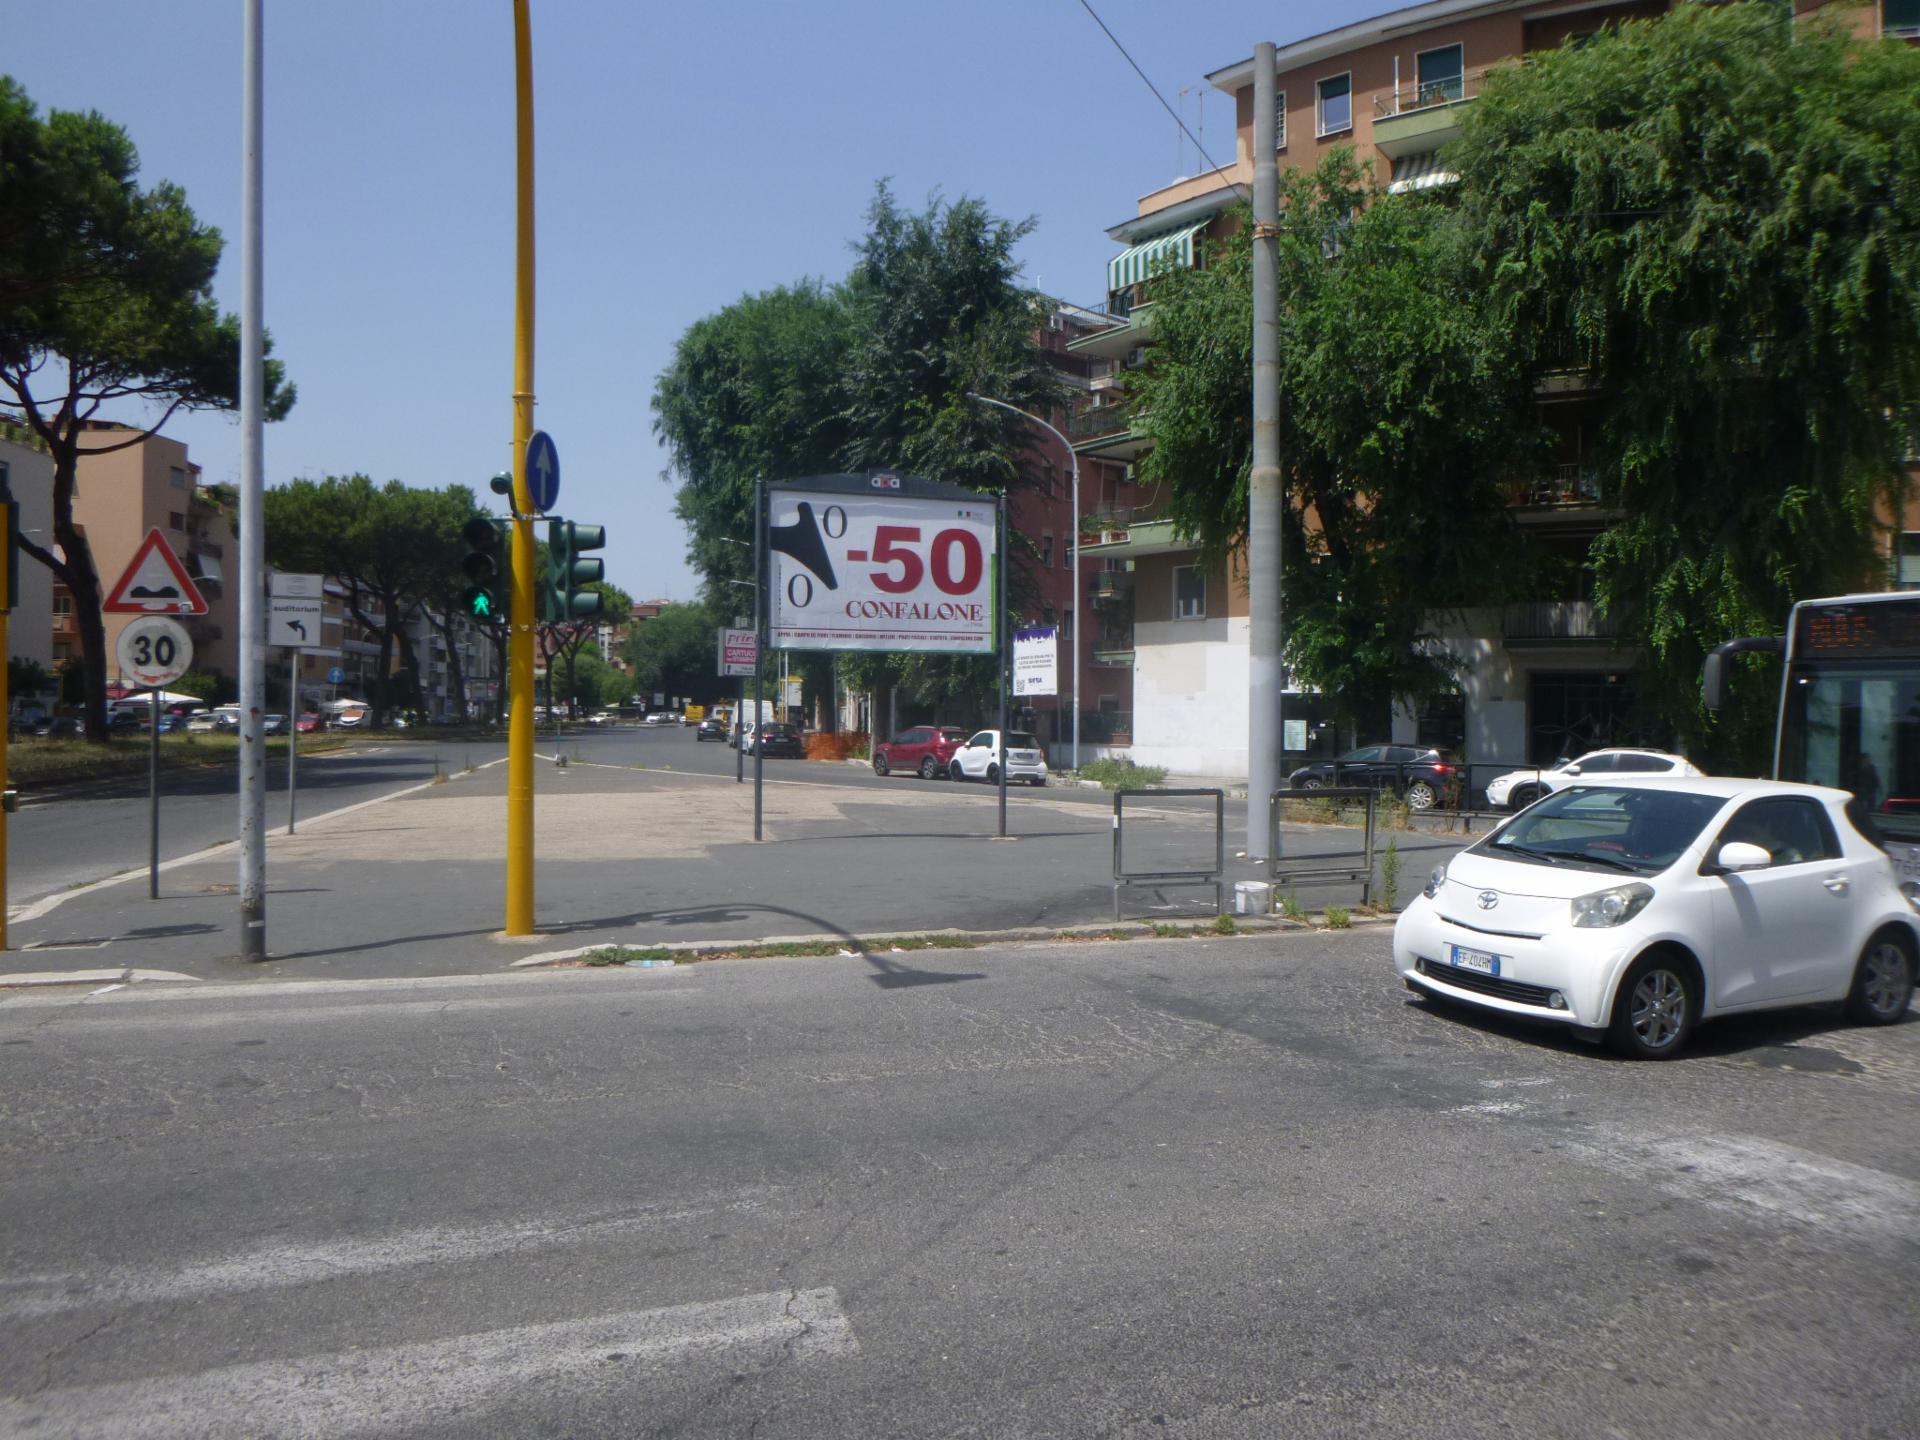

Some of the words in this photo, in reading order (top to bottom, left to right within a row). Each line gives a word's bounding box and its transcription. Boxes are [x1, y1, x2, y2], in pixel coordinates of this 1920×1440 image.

[273, 605, 320, 613] auditorium
[845, 600, 984, 622] CONFALONE
[134, 635, 176, 667] 30
